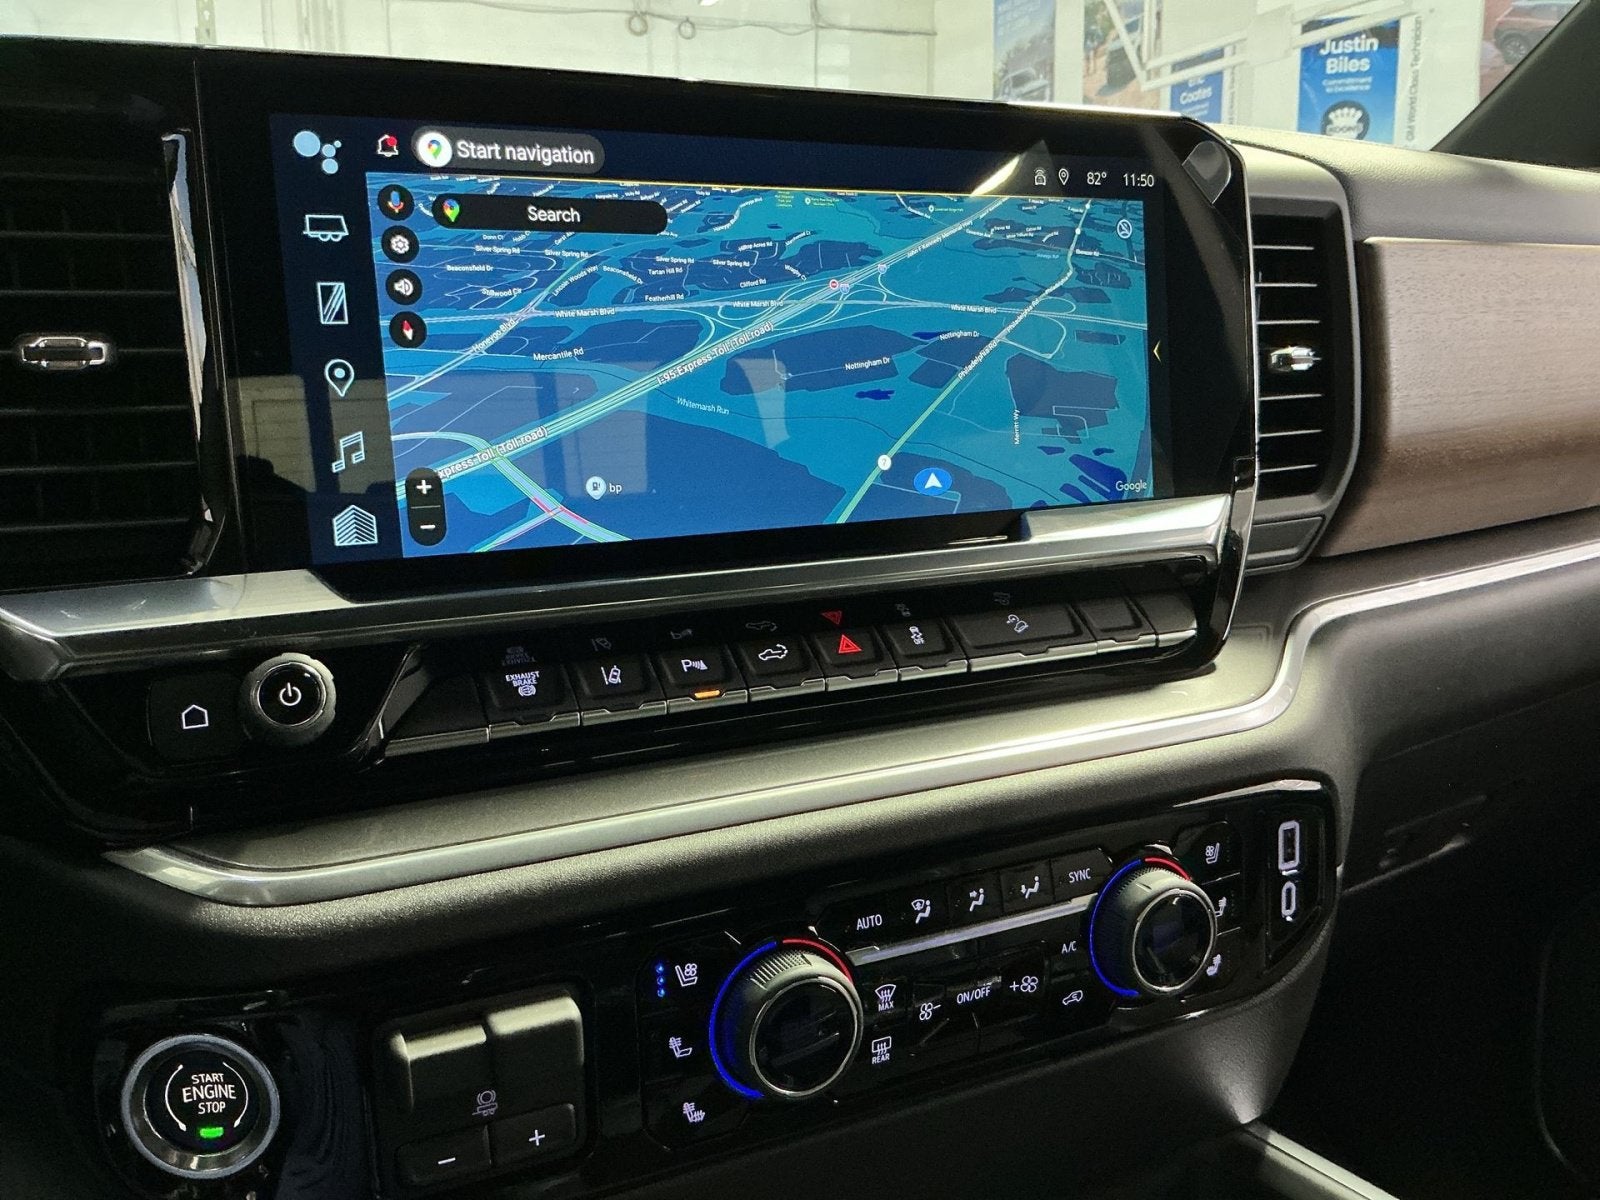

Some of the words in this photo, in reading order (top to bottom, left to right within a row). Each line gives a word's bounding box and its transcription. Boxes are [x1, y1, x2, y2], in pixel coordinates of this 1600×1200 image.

[1319, 34, 1379, 56] Justin
[1325, 56, 1371, 74] Biles
[1409, 70, 1419, 94] Class
[456, 141, 501, 160] Start
[505, 143, 594, 167] navigation
[1087, 172, 1107, 185] 82°
[1123, 173, 1155, 187] 11:50
[527, 206, 581, 223] Search
[492, 246, 511, 254] Spring
[544, 249, 561, 257] Silver
[561, 250, 579, 259] Spring
[554, 309, 576, 317] White
[576, 308, 598, 317] Marsh
[599, 308, 615, 316] Blvd
[939, 331, 973, 341] Nottingham
[532, 349, 572, 361] Mercantile
[573, 347, 584, 357] Rd
[676, 355, 713, 375] Express
[713, 342, 730, 358] Toll
[844, 358, 882, 371] Nottingham
[882, 357, 891, 365] Dr
[958, 347, 990, 380] Philadelphia
[676, 396, 715, 412] Whitemarsh
[716, 405, 730, 415] Run
[437, 457, 474, 479] xpress
[474, 448, 496, 465] Toll
[520, 425, 549, 447] road)
[609, 482, 623, 493] bp
[1115, 480, 1148, 492] Google
[505, 670, 540, 682] EXHAUST
[512, 677, 538, 687] BRAKE
[1068, 868, 1092, 883] SYNC
[856, 914, 883, 931] AUTO
[1061, 940, 1077, 954] A/C
[956, 986, 991, 1004] ON/OFF
[878, 1002, 894, 1012] MAX
[871, 1053, 891, 1065] REAR
[191, 1073, 224, 1085] START
[182, 1084, 237, 1103] ENGINE
[198, 1101, 226, 1115] STOP
